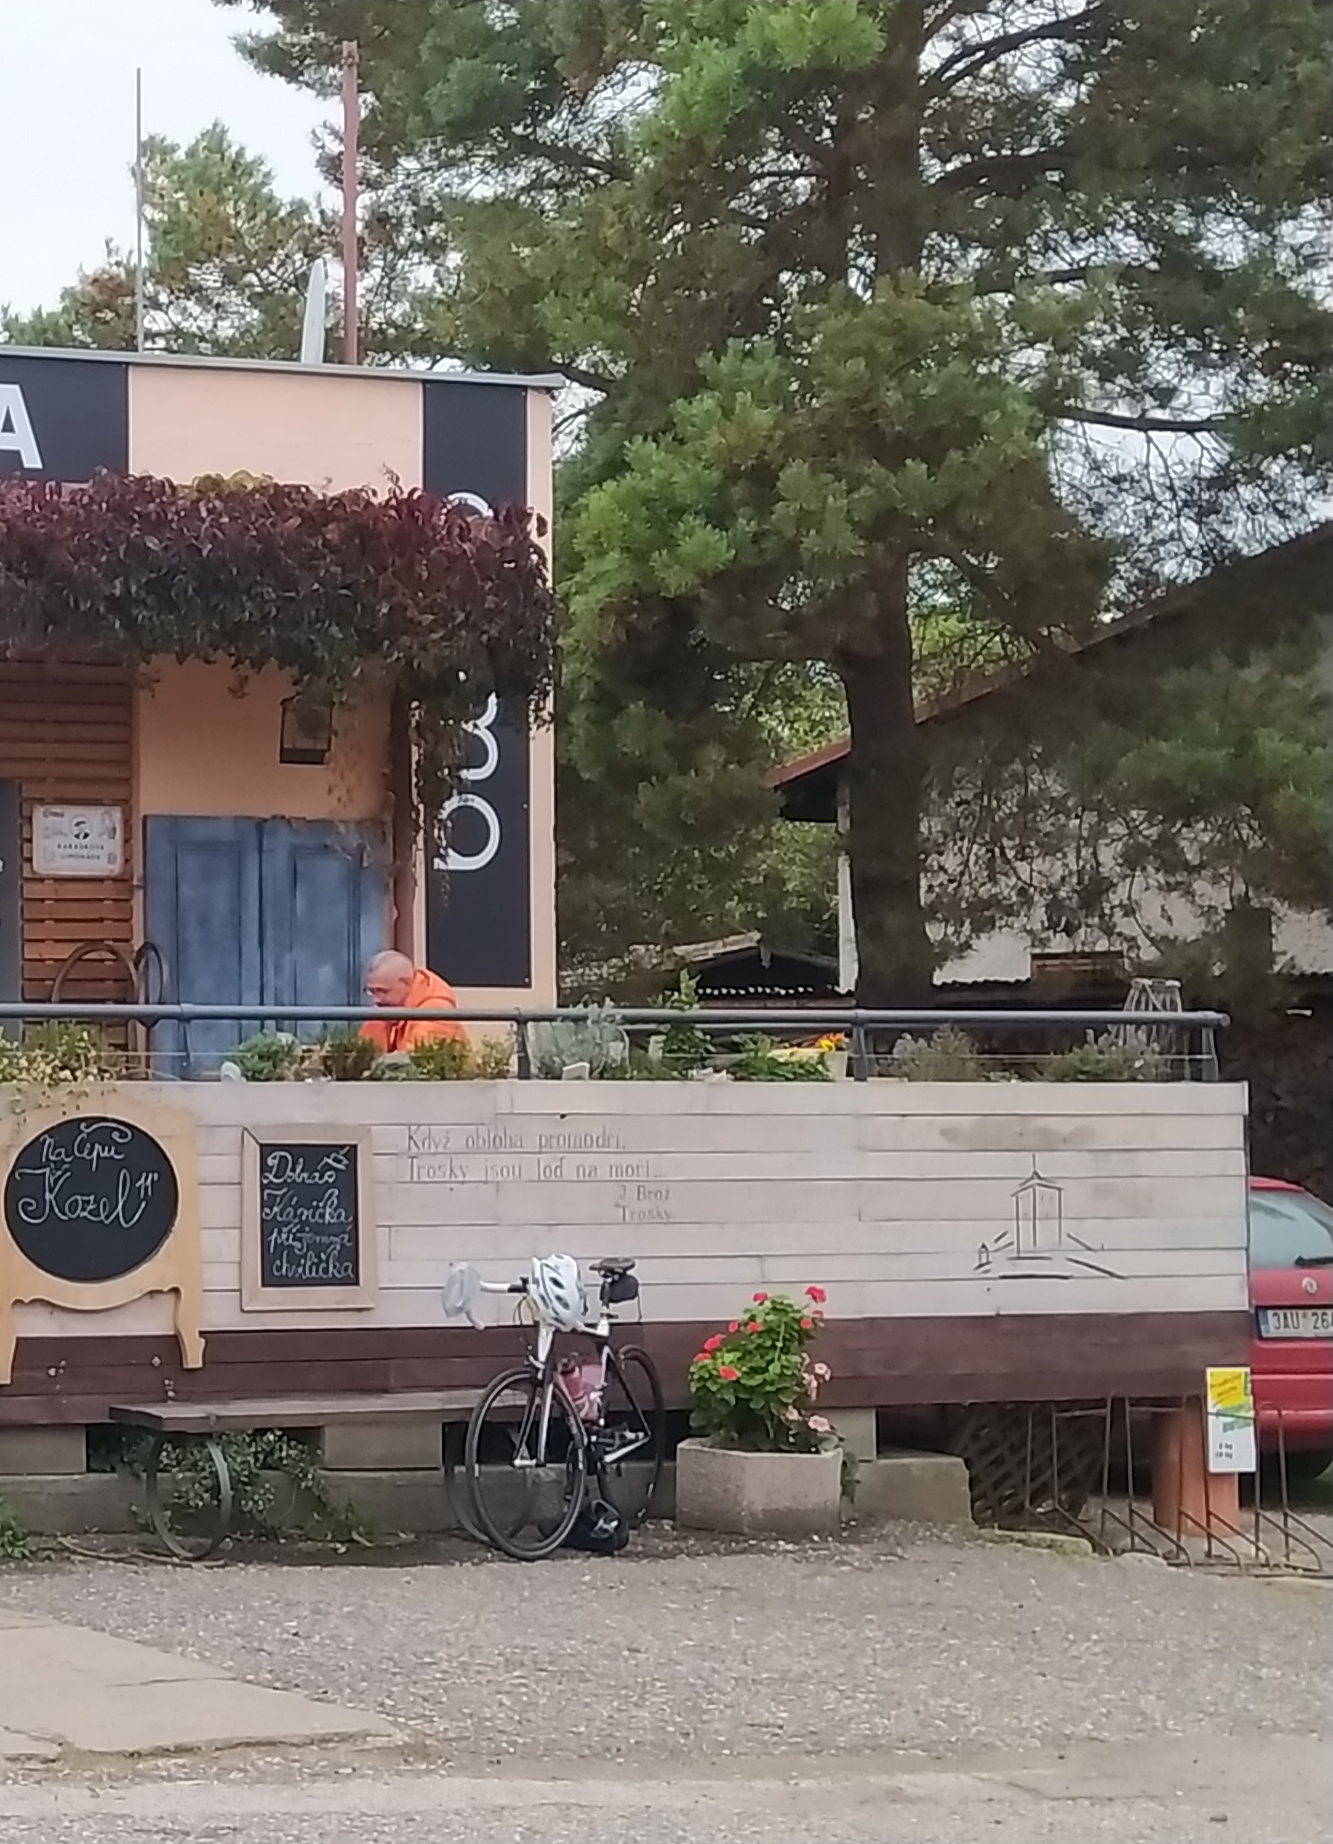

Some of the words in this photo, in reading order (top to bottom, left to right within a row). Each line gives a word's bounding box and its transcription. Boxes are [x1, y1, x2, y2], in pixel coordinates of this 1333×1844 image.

[465, 1125, 524, 1150] obloha
[407, 1155, 468, 1183] Trosky
[484, 1160, 522, 1186] jsou
[576, 1163, 598, 1179] na
[15, 1163, 146, 1228] Kozel
[614, 1201, 672, 1223] Trosky
[1311, 1311, 1333, 1330] 26
